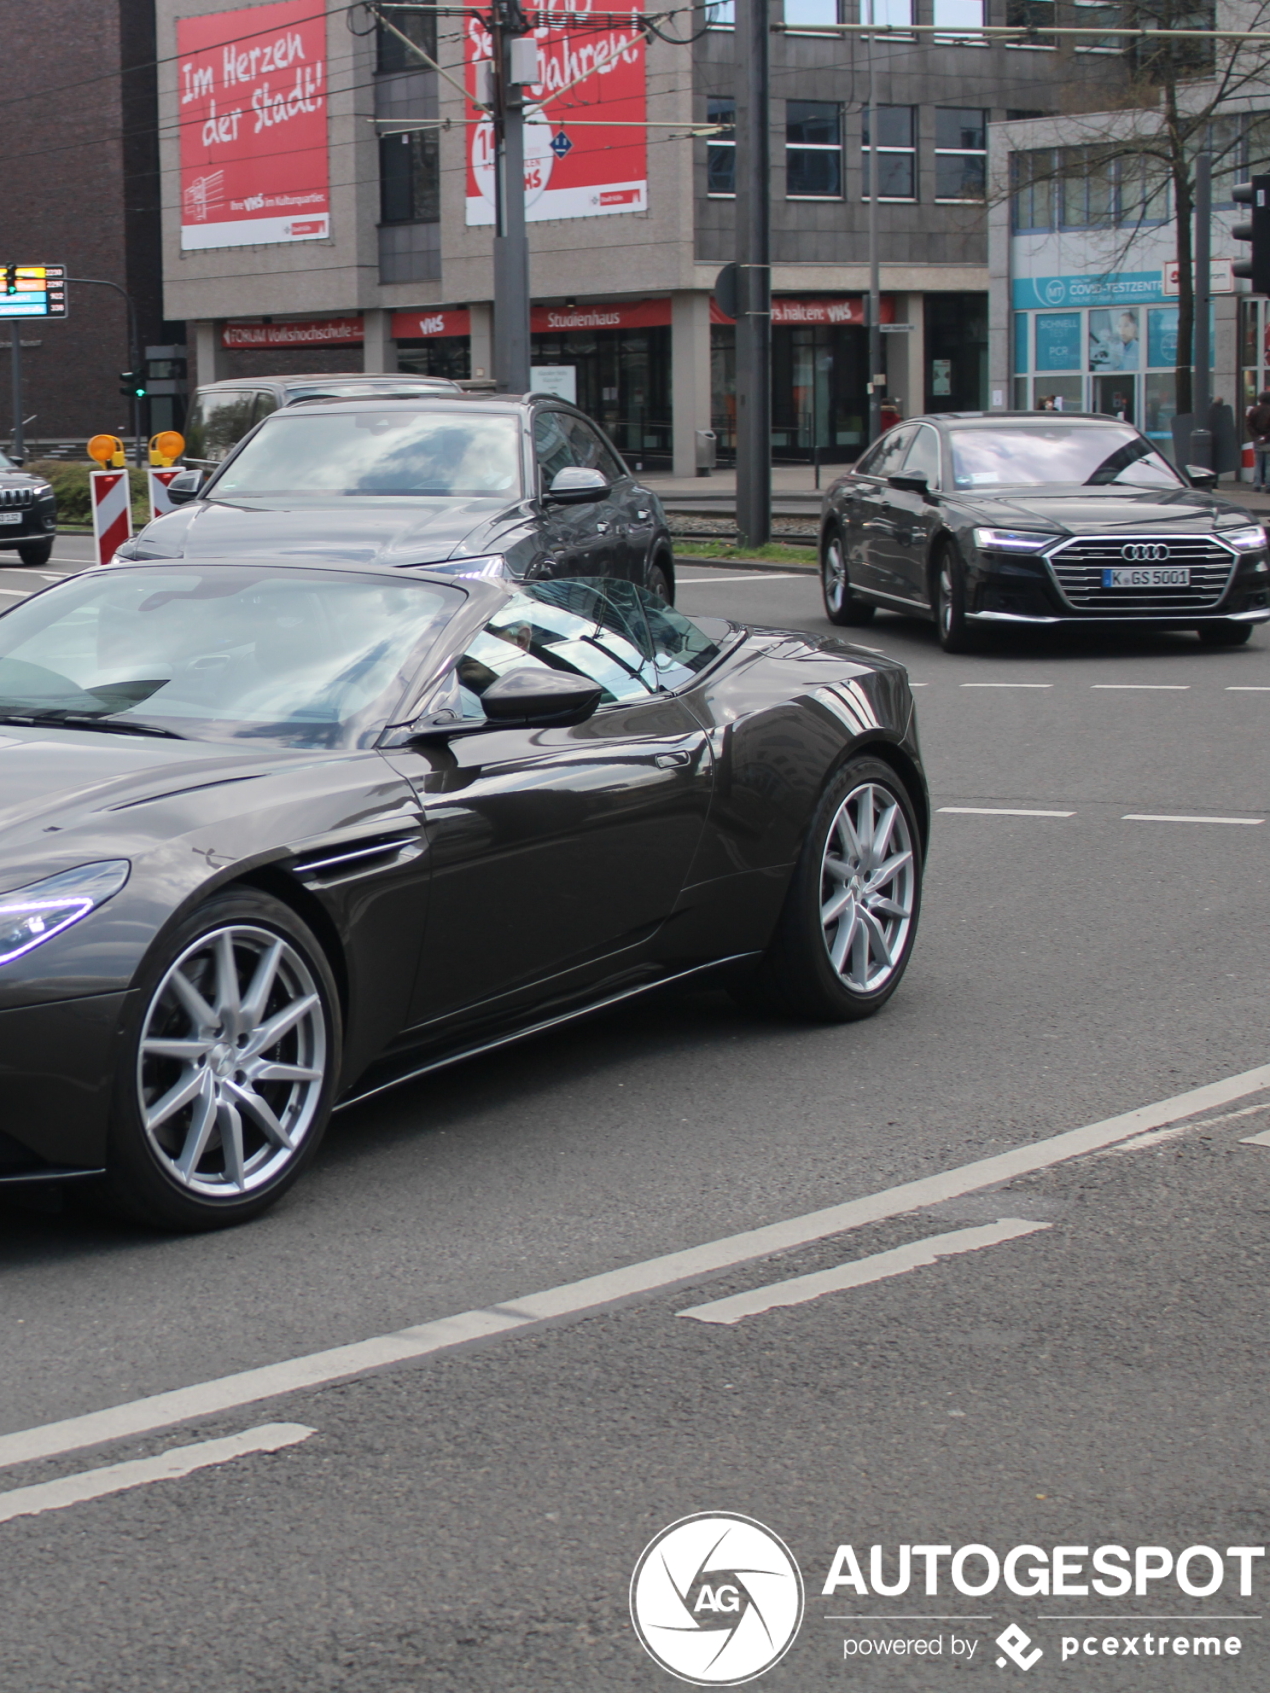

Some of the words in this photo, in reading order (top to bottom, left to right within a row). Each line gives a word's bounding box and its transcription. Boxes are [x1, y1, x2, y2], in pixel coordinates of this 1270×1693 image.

[531, 7, 638, 96] Jahren!
[182, 62, 214, 104] Im
[223, 32, 305, 88] Herzen
[202, 99, 243, 146] der
[251, 60, 323, 134] Stadt!
[244, 192, 265, 212] VHS
[1069, 280, 1162, 295] COVID-TESTZENTR
[548, 309, 620, 328] Studienhaus
[782, 304, 825, 321] halten:
[827, 302, 852, 323] VHS
[231, 329, 266, 343] FORUM
[268, 322, 352, 342] Volkshochschule
[419, 315, 445, 335] VHS
[1040, 319, 1078, 329] SCHNELL
[1049, 346, 1068, 356] PCR
[1112, 571, 1122, 585] K
[1131, 571, 1150, 585] GS
[1153, 570, 1188, 584] 5001
